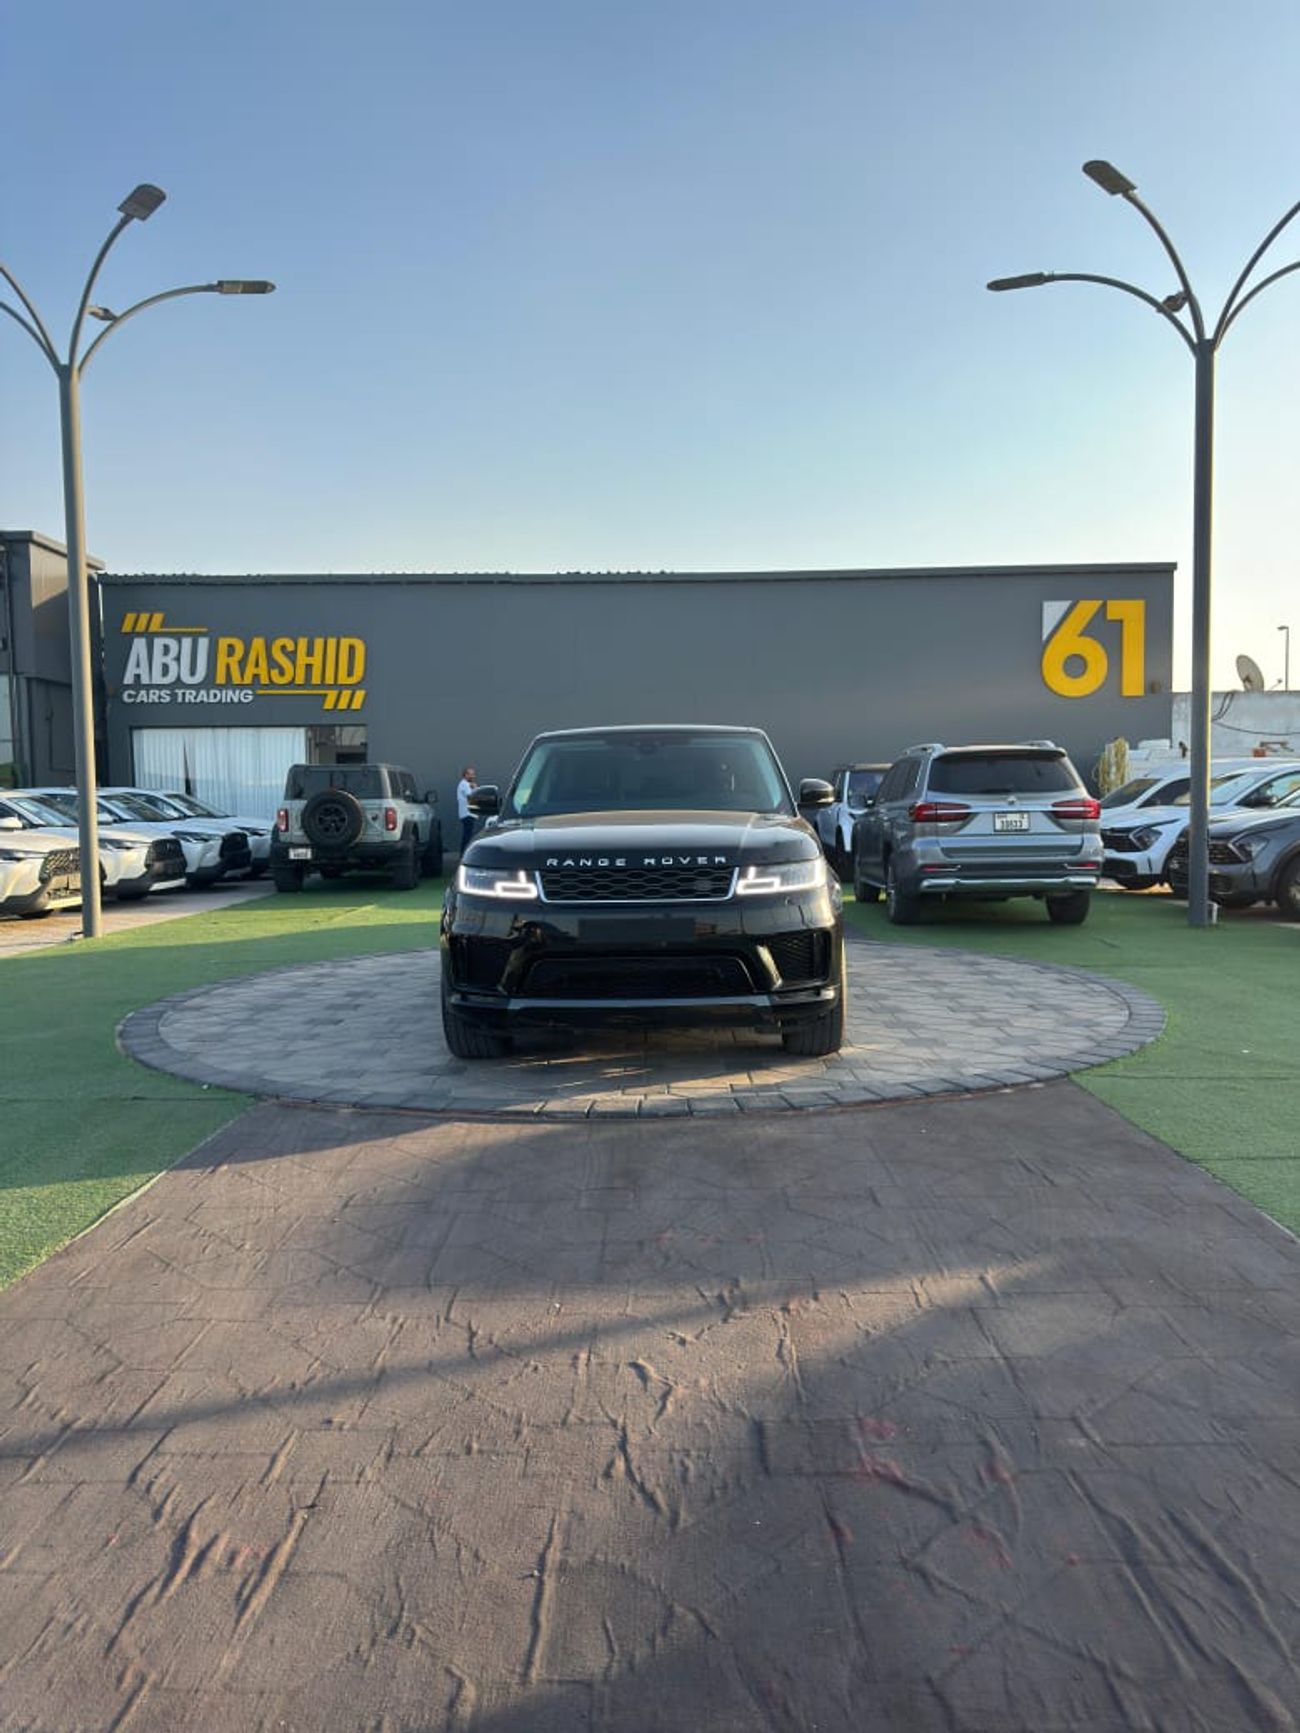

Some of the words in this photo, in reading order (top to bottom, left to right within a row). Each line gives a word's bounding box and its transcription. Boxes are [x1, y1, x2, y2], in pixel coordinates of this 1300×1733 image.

[123, 637, 209, 685] ABU
[215, 637, 366, 685] RASHID
[1042, 600, 1145, 697] 61
[122, 690, 170, 703] CARS
[175, 690, 254, 703] TRADING
[547, 858, 626, 866] RANGE
[644, 857, 726, 865] ROVER
